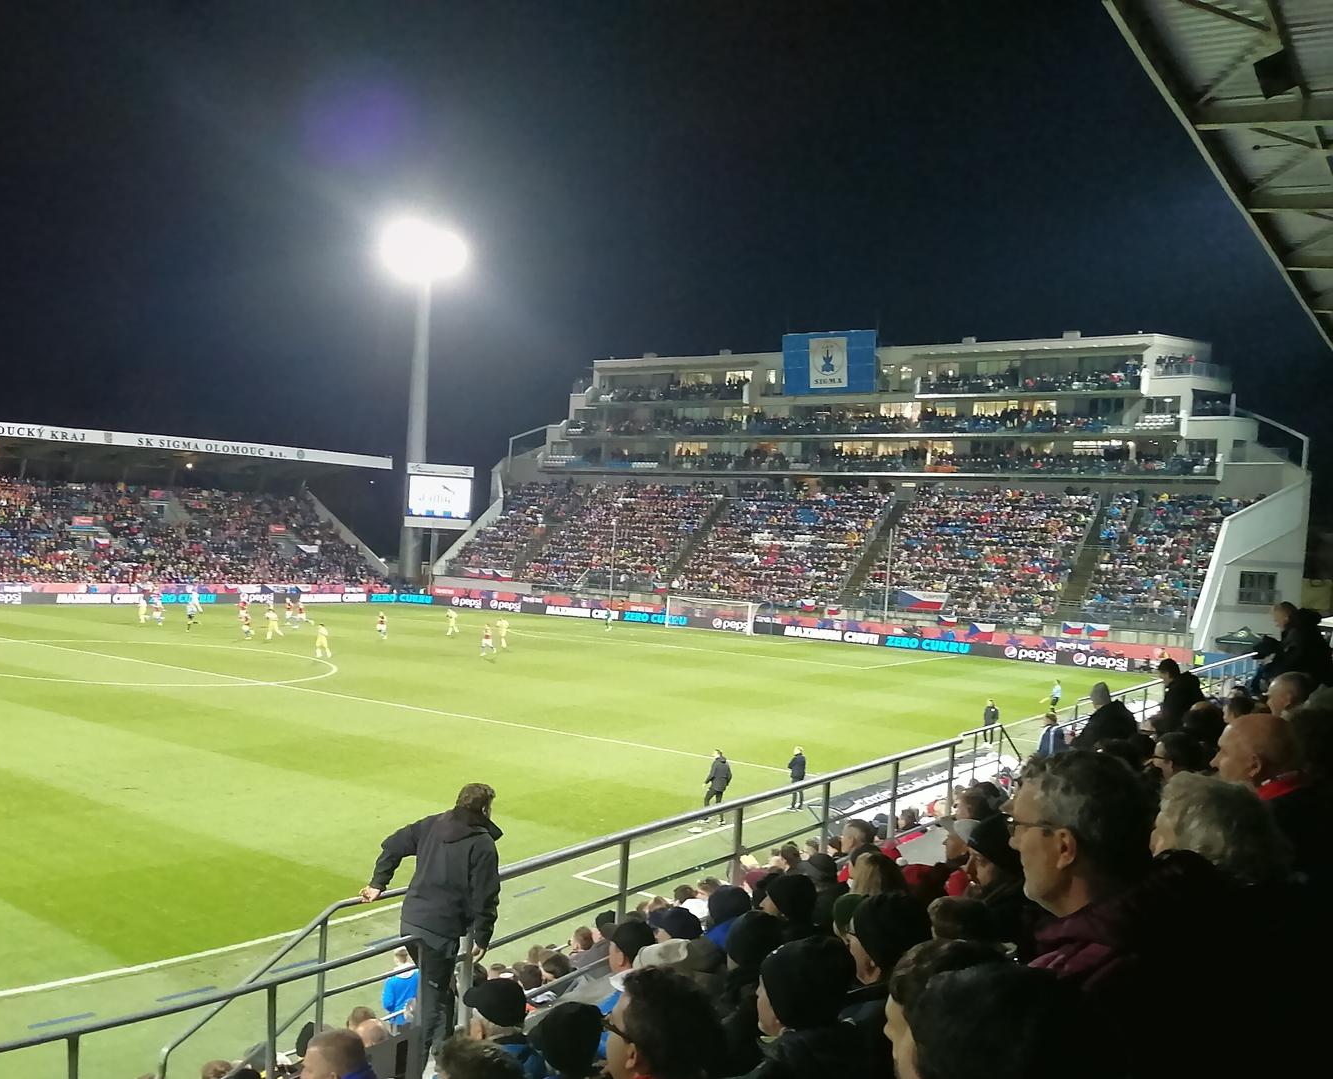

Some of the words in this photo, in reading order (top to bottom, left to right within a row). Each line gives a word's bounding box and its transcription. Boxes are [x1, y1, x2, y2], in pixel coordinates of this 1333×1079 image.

[50, 430, 86, 441] KRAJ
[137, 437, 153, 447] SK
[159, 439, 200, 450] SIGMA
[205, 443, 265, 456] OLOMOUC
[399, 593, 433, 604] CUKRU
[459, 597, 482, 609] pepsi
[497, 601, 521, 612] pepsi
[624, 611, 650, 623] ZERO
[722, 619, 748, 633] peps
[885, 635, 920, 649] ZERO
[922, 638, 971, 654] CUKRU
[1018, 648, 1057, 664] pepsi
[1087, 654, 1129, 669] pepsi
